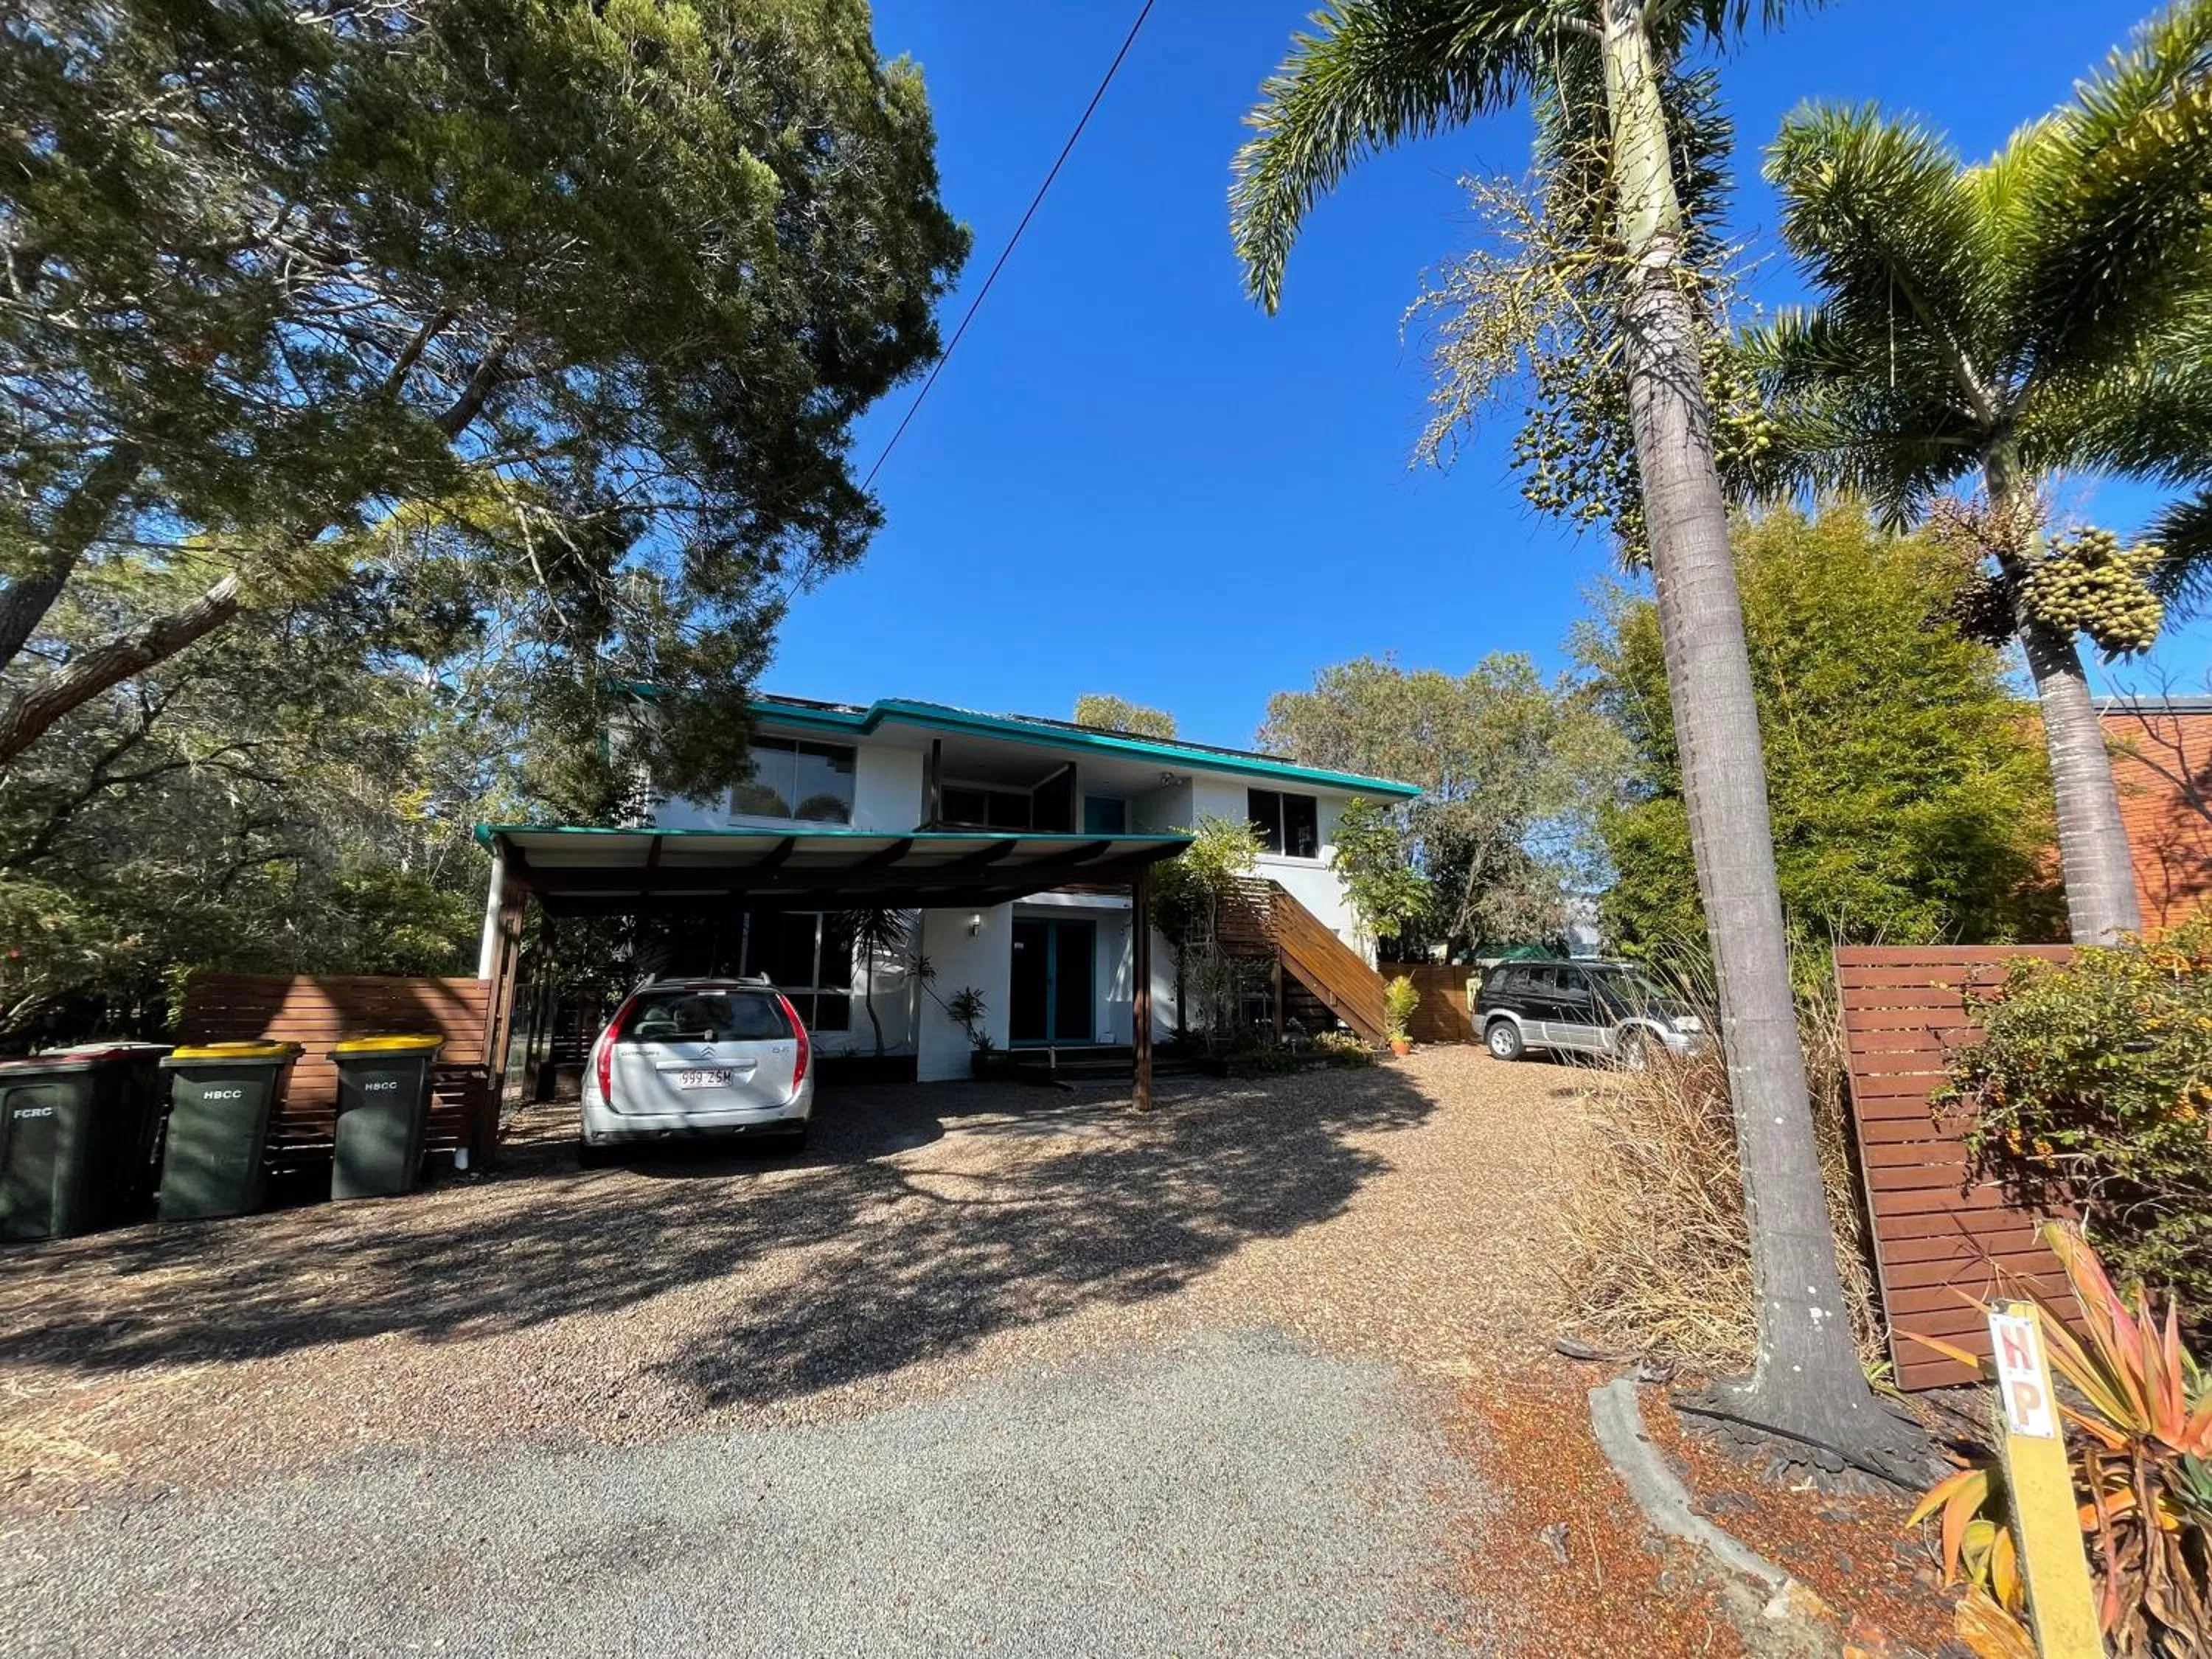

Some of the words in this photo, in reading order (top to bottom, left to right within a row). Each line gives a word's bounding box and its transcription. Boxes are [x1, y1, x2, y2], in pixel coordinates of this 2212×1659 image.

[682, 1071, 703, 1084] 999
[365, 1082, 397, 1091] HBCC
[204, 1089, 243, 1099] HBCC
[13, 1107, 53, 1119] FCRC
